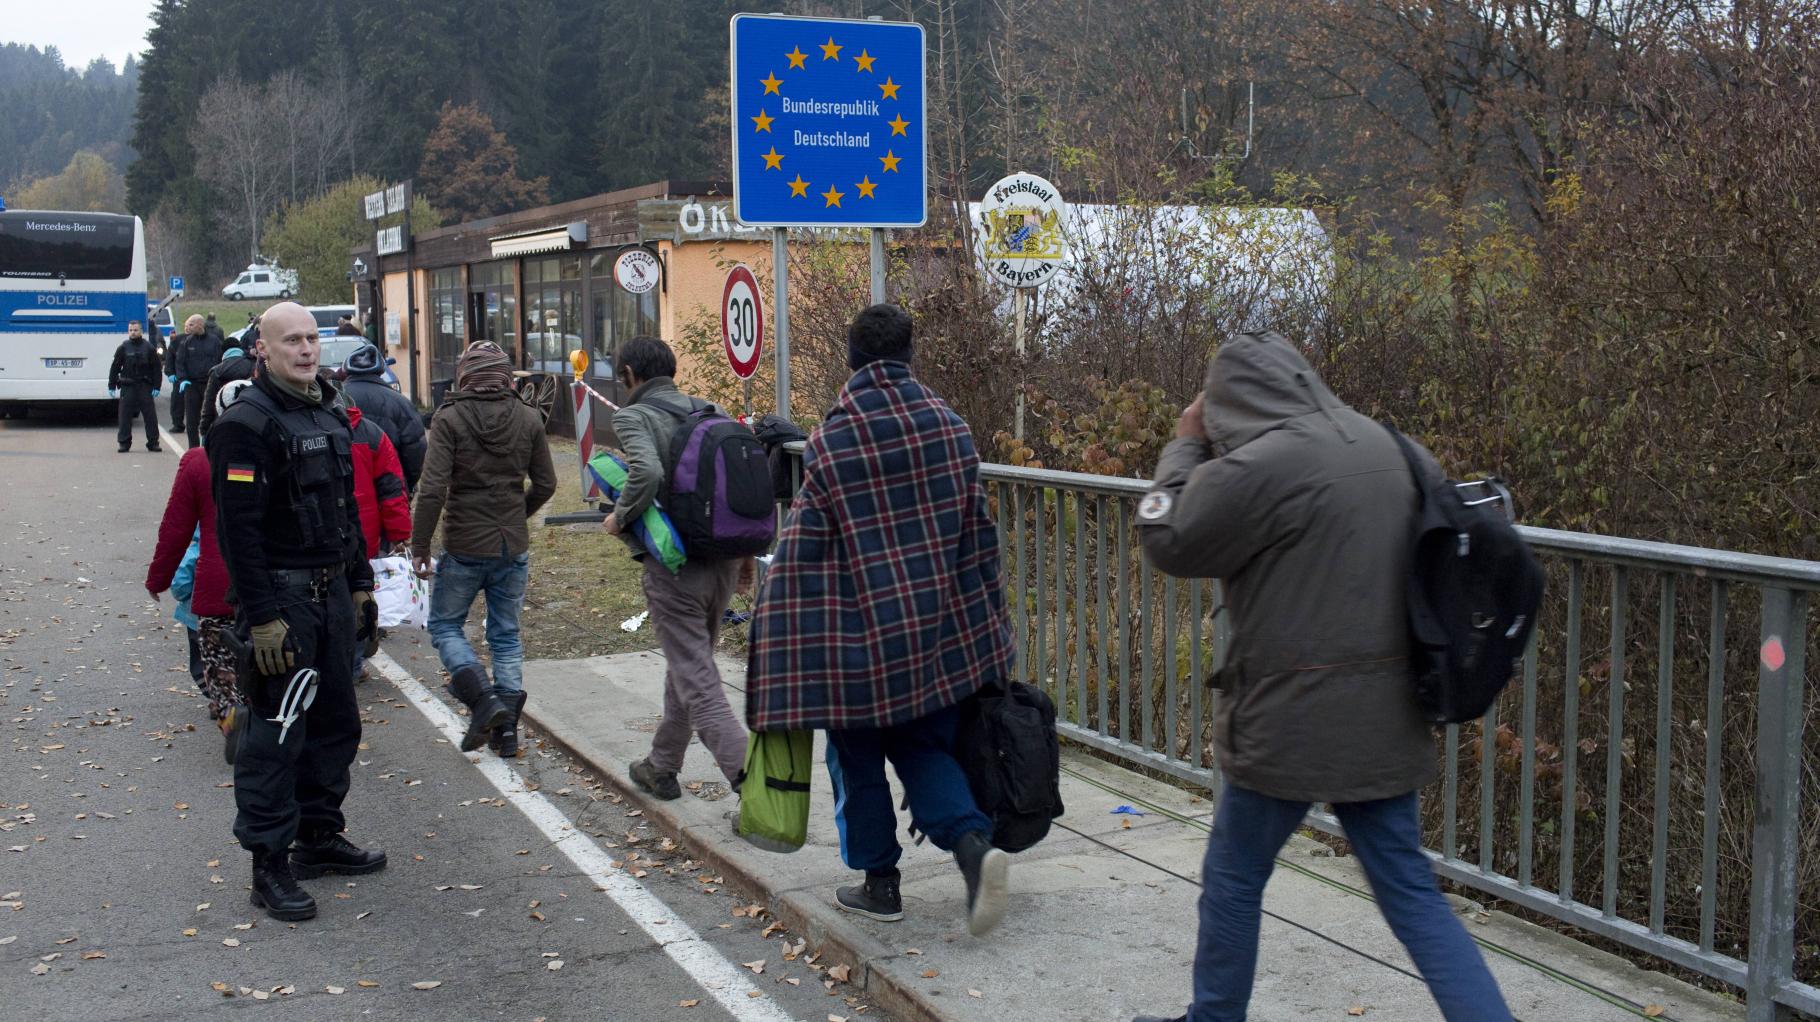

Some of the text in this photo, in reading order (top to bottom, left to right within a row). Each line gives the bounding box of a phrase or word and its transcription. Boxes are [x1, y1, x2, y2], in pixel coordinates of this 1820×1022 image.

[782, 97, 880, 119] Bundesrepublik
[793, 129, 870, 147] Deutschland
[993, 179, 1053, 203] Freistaat
[26, 221, 97, 232] Mercedes-Benz
[996, 261, 1053, 286] Bayern
[172, 278, 181, 289] P
[37, 294, 88, 305] POLIZEI
[730, 297, 754, 348] 30
[302, 436, 327, 451] POLIZEI
